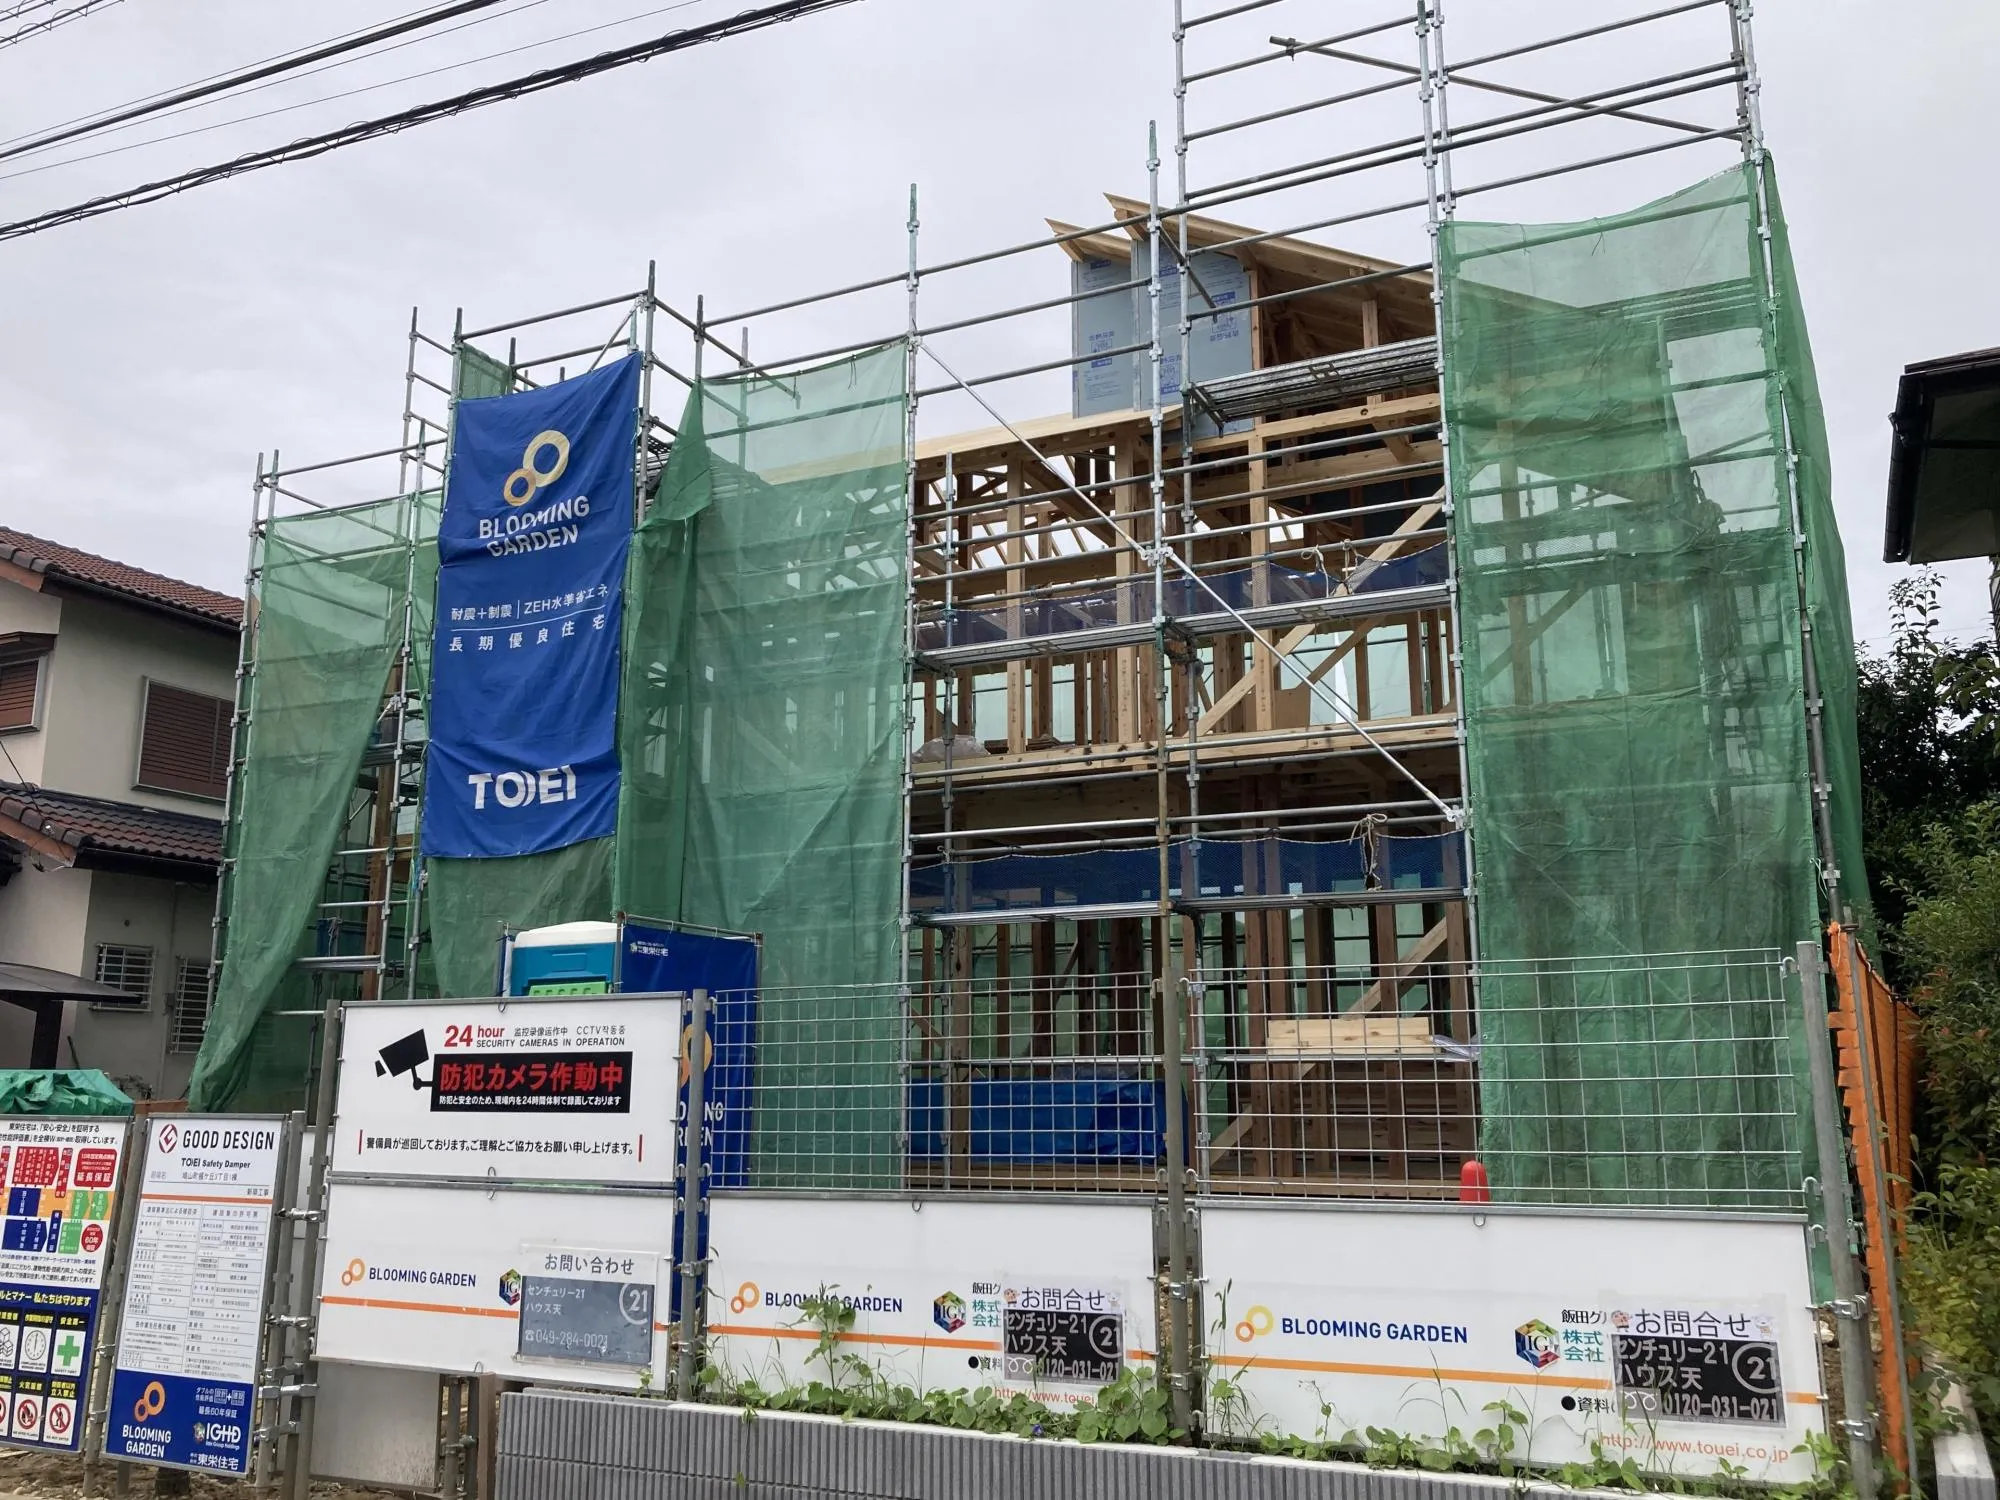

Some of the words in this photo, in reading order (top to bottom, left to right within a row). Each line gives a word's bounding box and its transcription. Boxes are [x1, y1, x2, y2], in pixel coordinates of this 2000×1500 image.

[479, 495, 590, 540] BLOOMING
[487, 526, 578, 557] GARDEN
[449, 614, 606, 652] 長期優良住宅
[444, 1024, 473, 1048] 24
[477, 1025, 506, 1038] hour
[477, 1039, 515, 1048] SECURITY
[520, 1038, 558, 1047] CAMERAS
[563, 1038, 571, 1046] IN
[576, 1037, 625, 1046] OPERATION
[440, 1060, 623, 1092] 防犯カメラ作動中
[183, 1130, 219, 1149] GOOD
[223, 1131, 274, 1150] DESIGN
[366, 1135, 634, 1156] 警備員が巡回しております。ご理解とご協力をお願い申し上げます。
[203, 1159, 223, 1169] Safety
[225, 1160, 251, 1169] Damper
[544, 1253, 635, 1275] お問い合わせ
[368, 1267, 427, 1284] BLOOMING
[430, 1270, 477, 1288] GARDEN
[33, 1292, 91, 1306] 私たちは守ります
[525, 1303, 562, 1315] ハウス天
[972, 1299, 1001, 1313] 株式
[1021, 1287, 1105, 1311] お問合せ
[972, 1314, 1001, 1327] 会社
[1282, 1317, 1381, 1338] BLOOMING
[1387, 1323, 1468, 1343] GARDEN
[1635, 1309, 1751, 1338] お問合せ
[1004, 1335, 1067, 1356] ハウス天
[1563, 1329, 1602, 1345] 株式
[1564, 1346, 1605, 1362] 会社
[122, 1424, 172, 1444] BLOOMING
[126, 1440, 165, 1458] GARDEN
[198, 1453, 239, 1471] 東栄住宅
